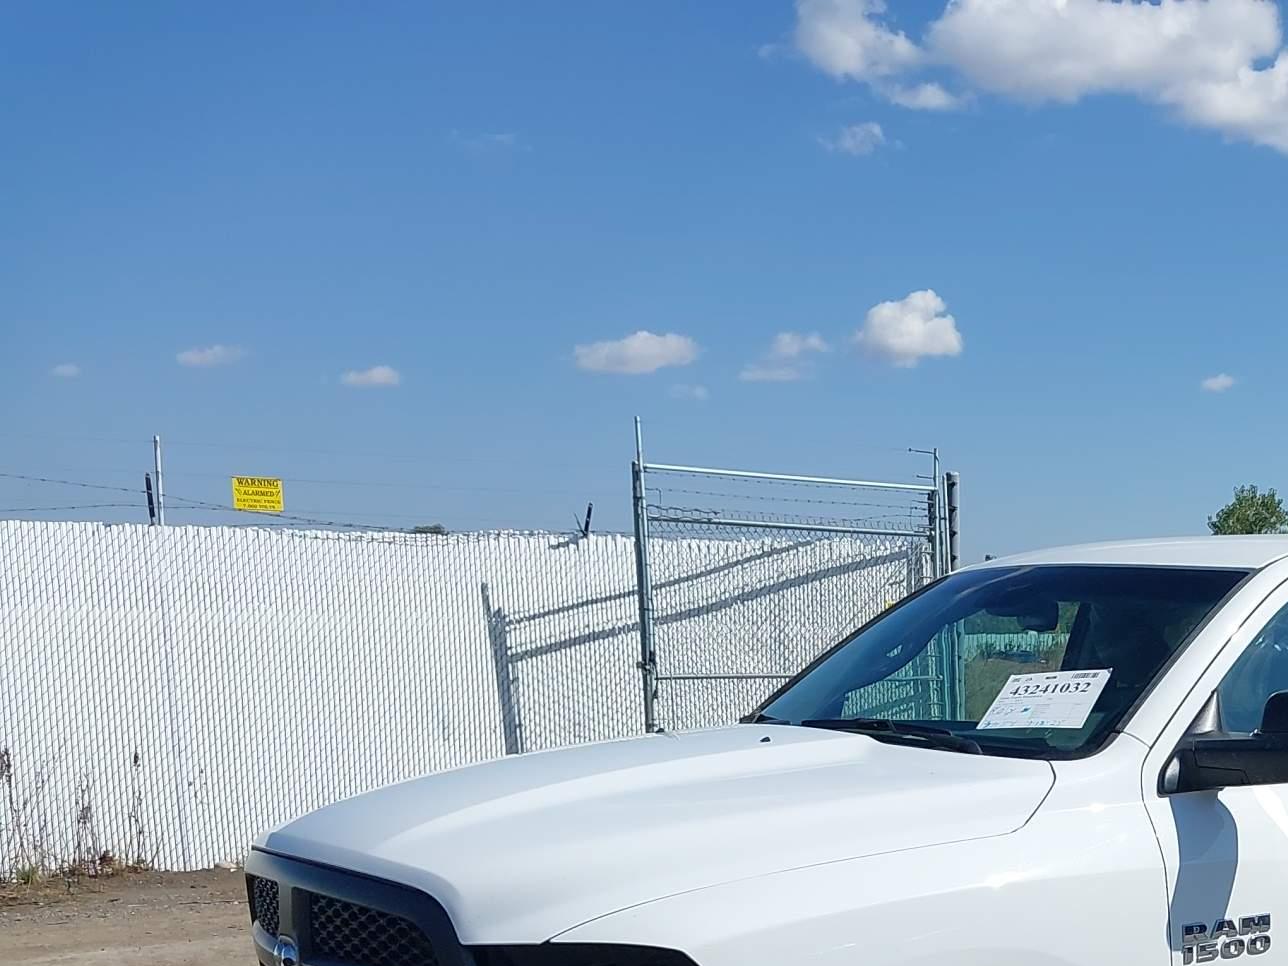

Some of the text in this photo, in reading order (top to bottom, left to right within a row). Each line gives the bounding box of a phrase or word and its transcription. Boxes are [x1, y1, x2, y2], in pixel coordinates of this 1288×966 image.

[236, 478, 279, 487] WARNING
[1009, 682, 1092, 697] 43241032
[1181, 913, 1271, 943] RAM
[1182, 934, 1272, 966] 1500
